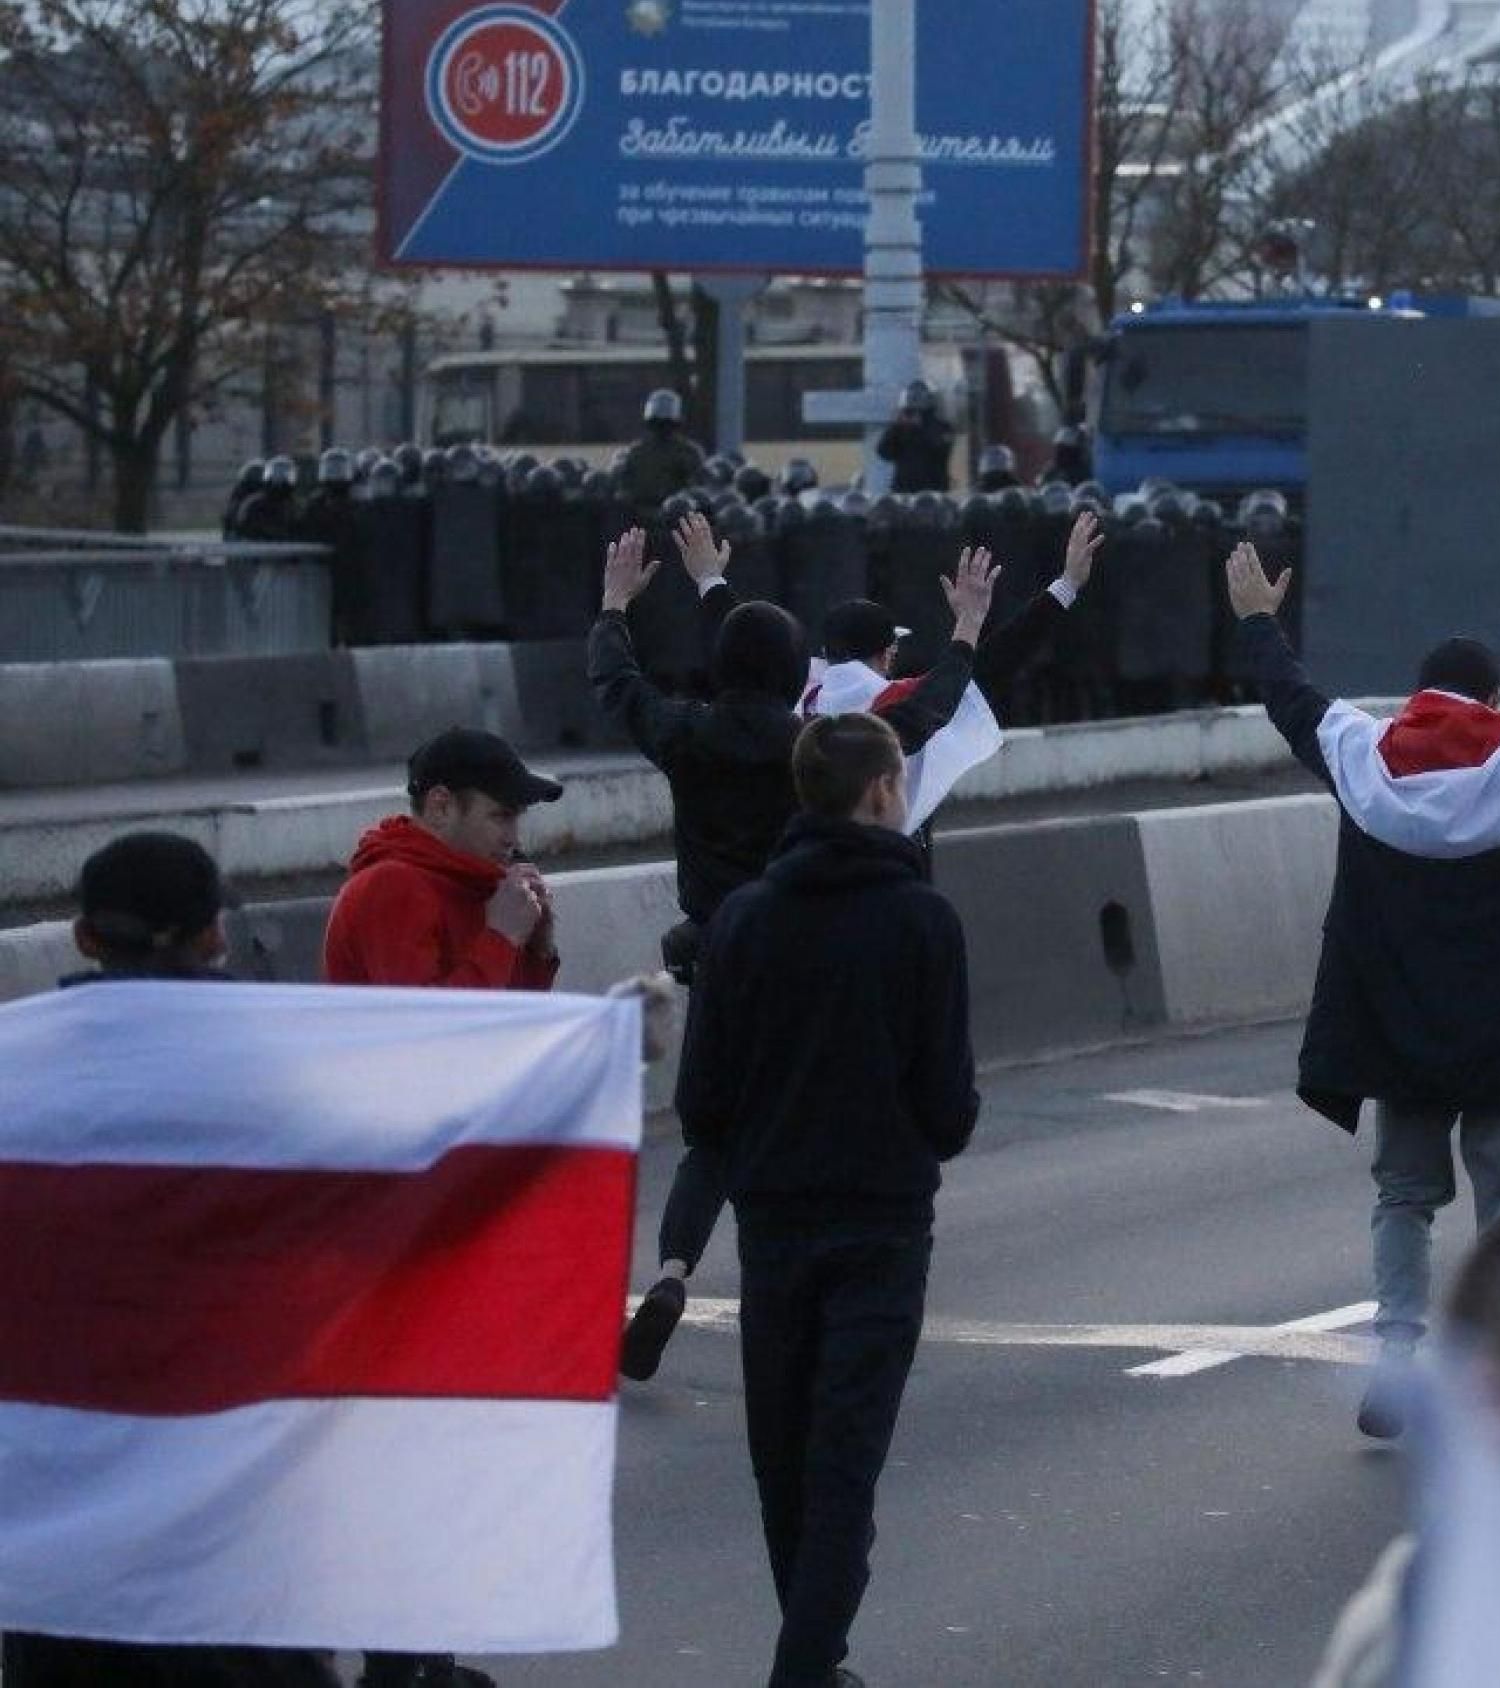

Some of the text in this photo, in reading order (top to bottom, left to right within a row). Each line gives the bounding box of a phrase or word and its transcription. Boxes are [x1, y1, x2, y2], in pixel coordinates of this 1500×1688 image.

[504, 51, 548, 116] 112
[620, 69, 872, 99] БЛАГОДАРНОС
[619, 117, 1055, 162] Заботливым ителям
